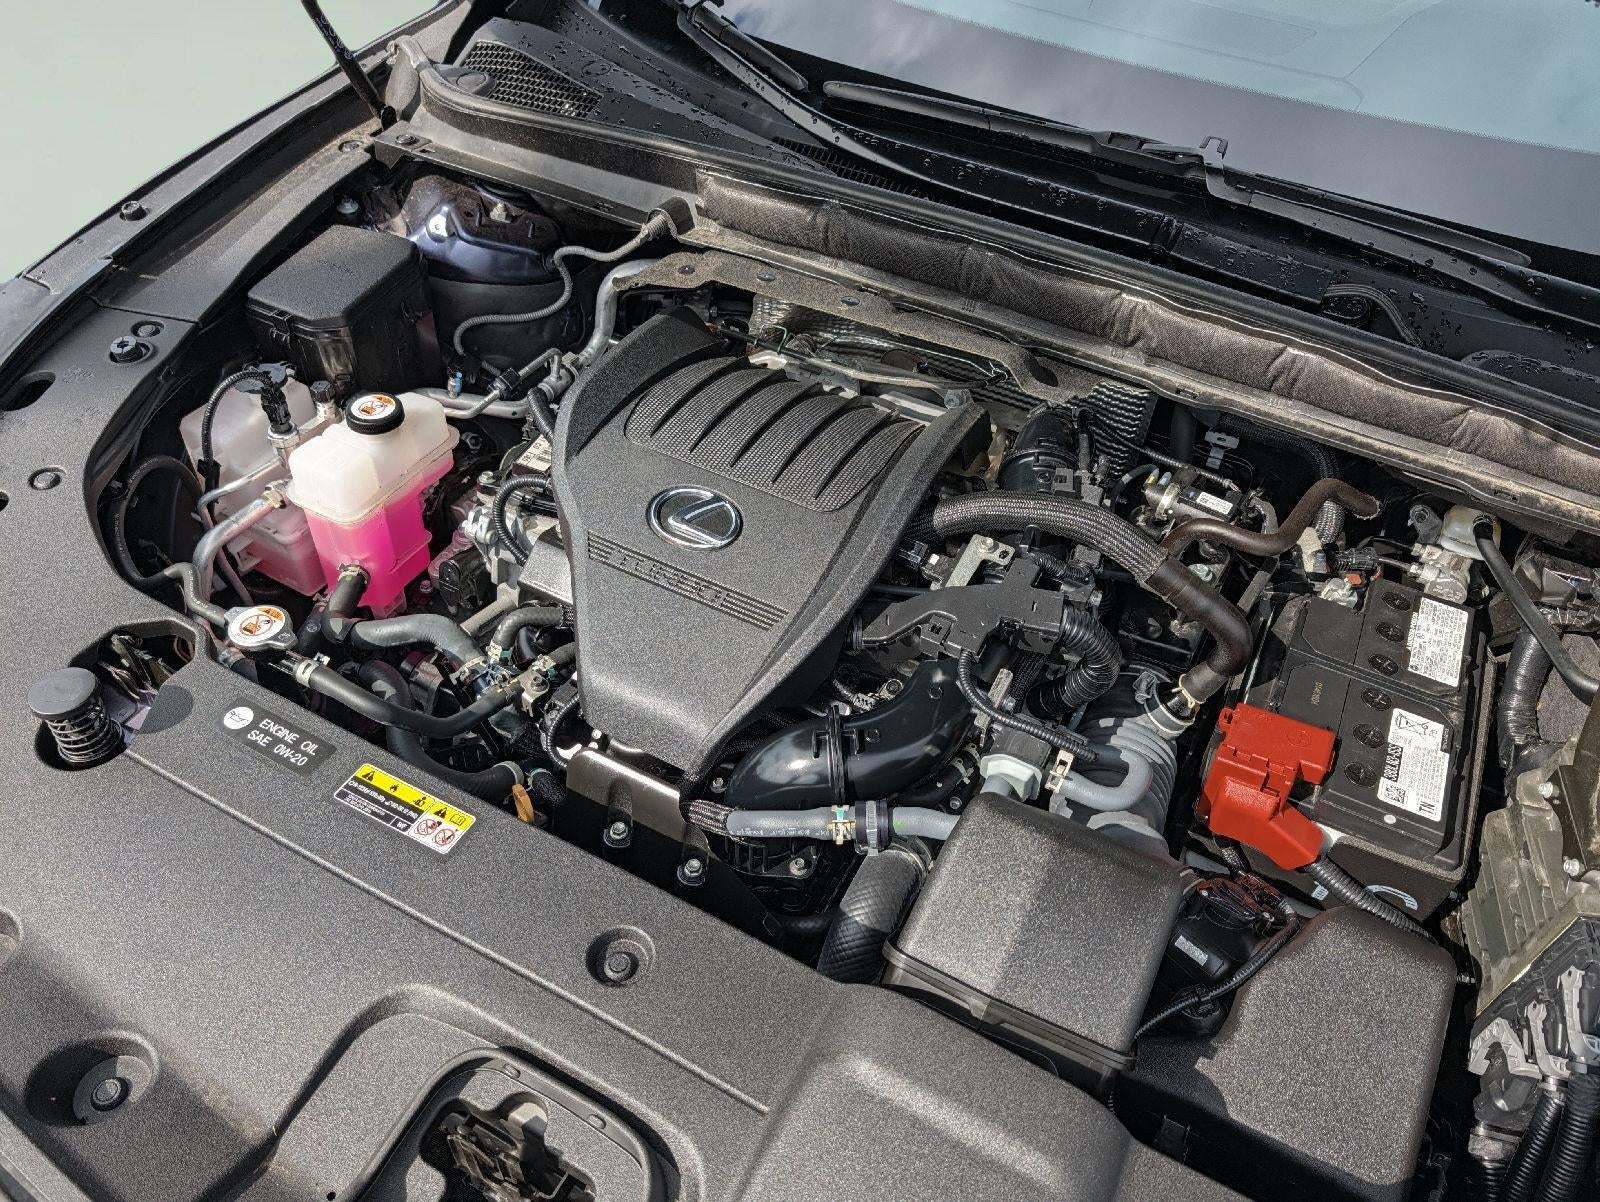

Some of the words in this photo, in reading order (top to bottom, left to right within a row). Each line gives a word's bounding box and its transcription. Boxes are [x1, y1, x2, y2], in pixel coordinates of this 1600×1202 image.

[247, 730, 273, 747] SAE
[273, 743, 308, 766] 0W-20
[259, 718, 299, 744] ENGINE
[300, 741, 319, 756] OIL
[1418, 800, 1435, 815] TN
